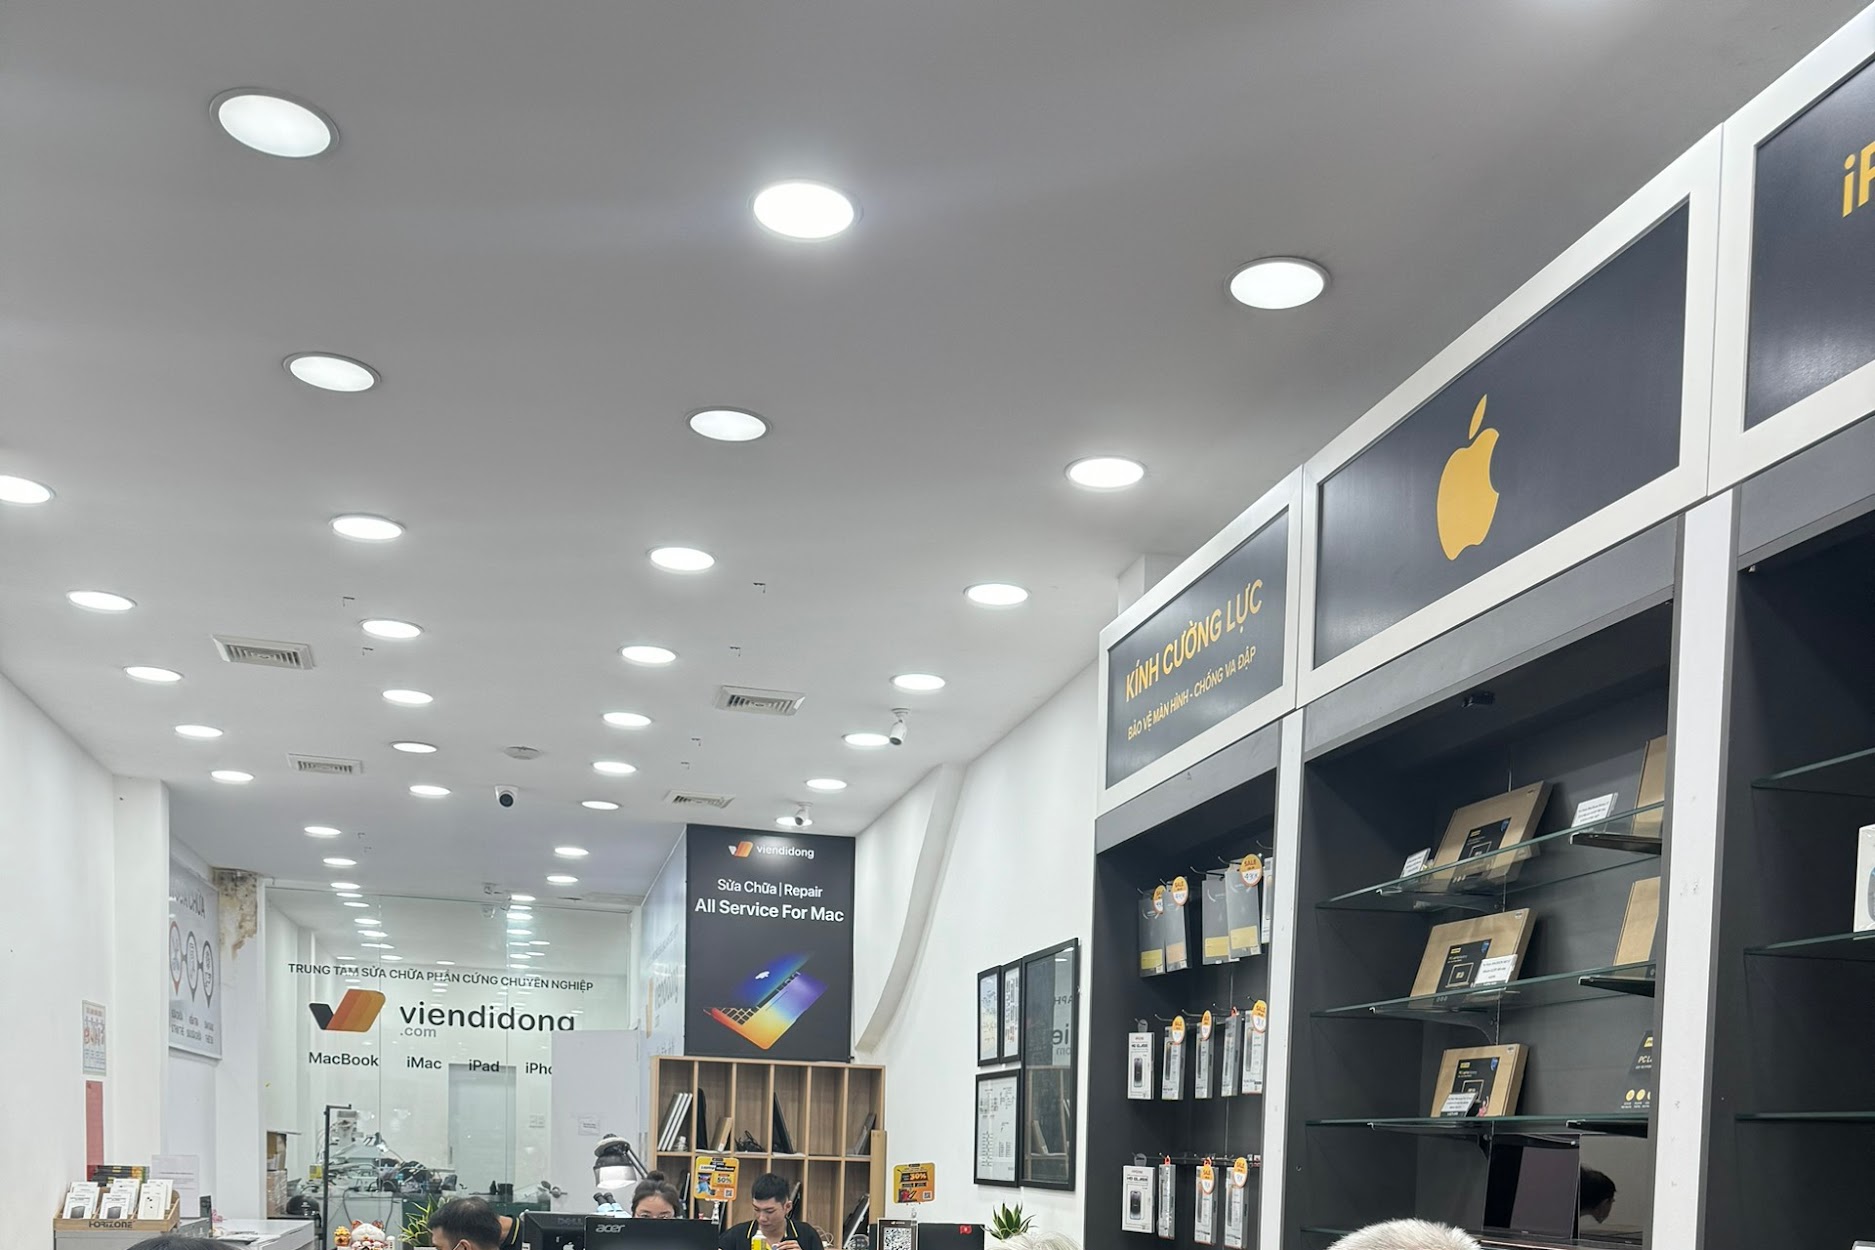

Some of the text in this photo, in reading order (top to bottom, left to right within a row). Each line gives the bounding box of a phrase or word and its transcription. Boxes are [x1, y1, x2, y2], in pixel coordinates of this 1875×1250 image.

[1126, 578, 1263, 702] KÍNH CƯỜNG LỰC
[1127, 719, 1143, 741] BẢO
[1152, 701, 1170, 725] MÀN
[1193, 667, 1224, 698] CHỐNG
[1224, 658, 1237, 678] VA
[756, 844, 815, 860] viendidong
[717, 878, 742, 893] Sửa
[743, 880, 778, 895] Chữa
[783, 883, 824, 899] Repair
[694, 897, 845, 923] All Service For Mac
[288, 963, 331, 976] TRUNG
[361, 965, 387, 979] SỬA
[389, 967, 425, 981] CHỮA
[462, 971, 498, 985] CỨNG
[551, 979, 594, 993] NGHIỆP
[399, 1025, 437, 1038] .com
[308, 1051, 379, 1068] MacBook
[406, 1056, 442, 1070] iMac
[468, 1058, 500, 1073] iPad
[595, 1223, 626, 1233] acer
